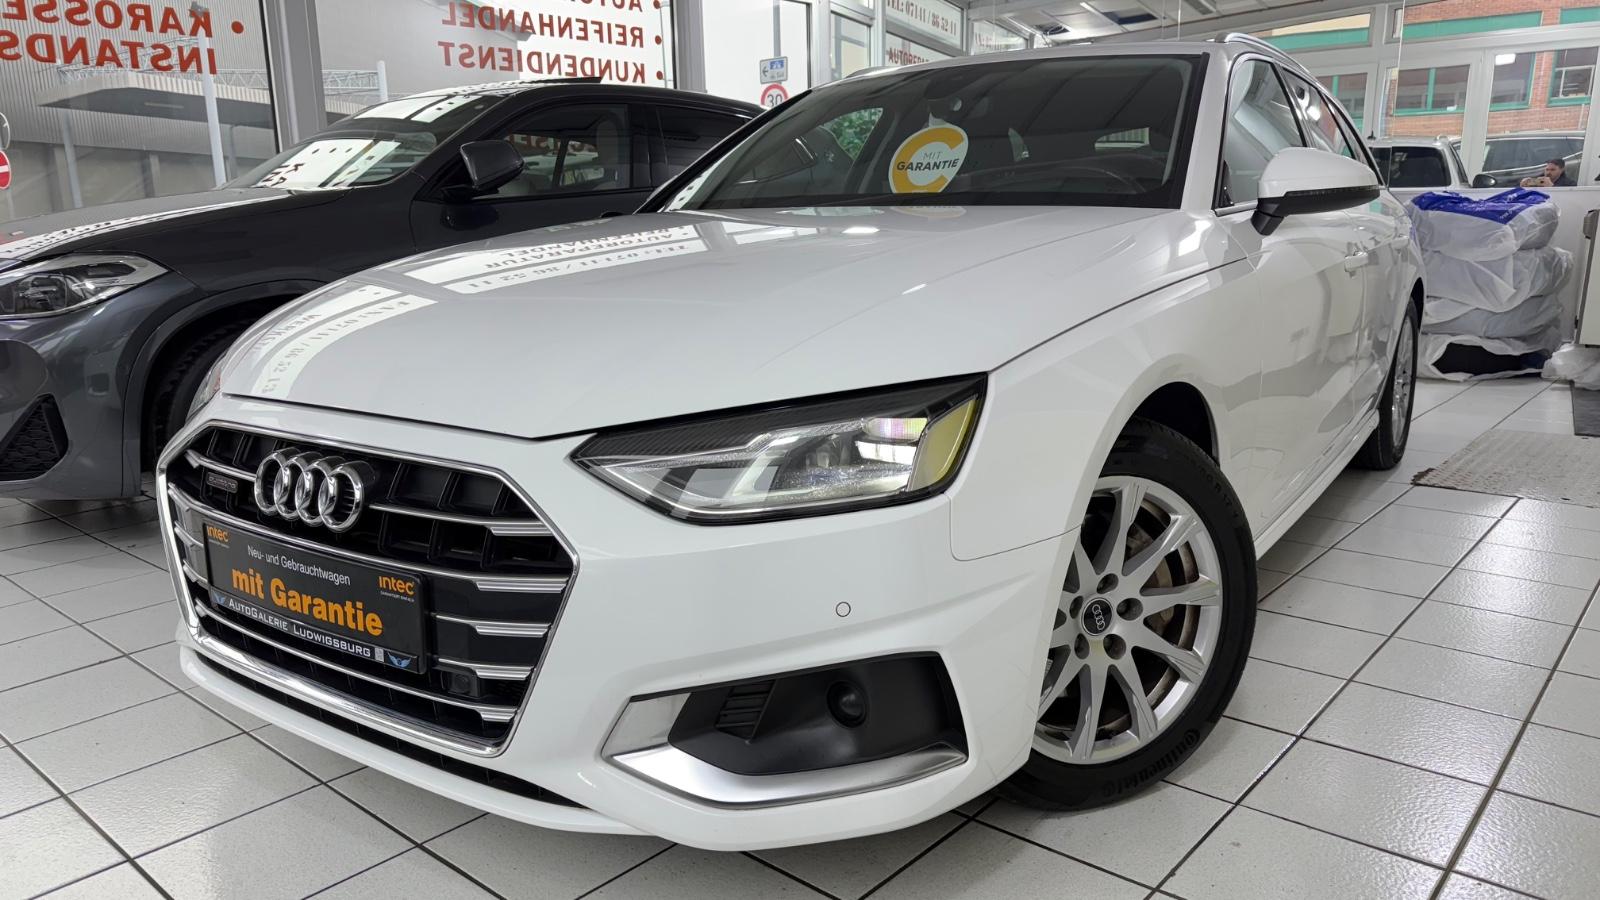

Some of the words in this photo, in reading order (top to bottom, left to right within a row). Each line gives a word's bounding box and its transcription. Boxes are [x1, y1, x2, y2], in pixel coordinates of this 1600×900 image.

[941, 17, 949, 32] 52
[950, 21, 957, 36] 11
[897, 158, 959, 172] GARANTIE
[922, 152, 942, 160] MIT
[265, 552, 279, 566] und
[281, 555, 351, 587] Gebrauchtwagen
[379, 575, 415, 596] intec
[231, 567, 265, 600] mit
[270, 577, 384, 637] Garantie
